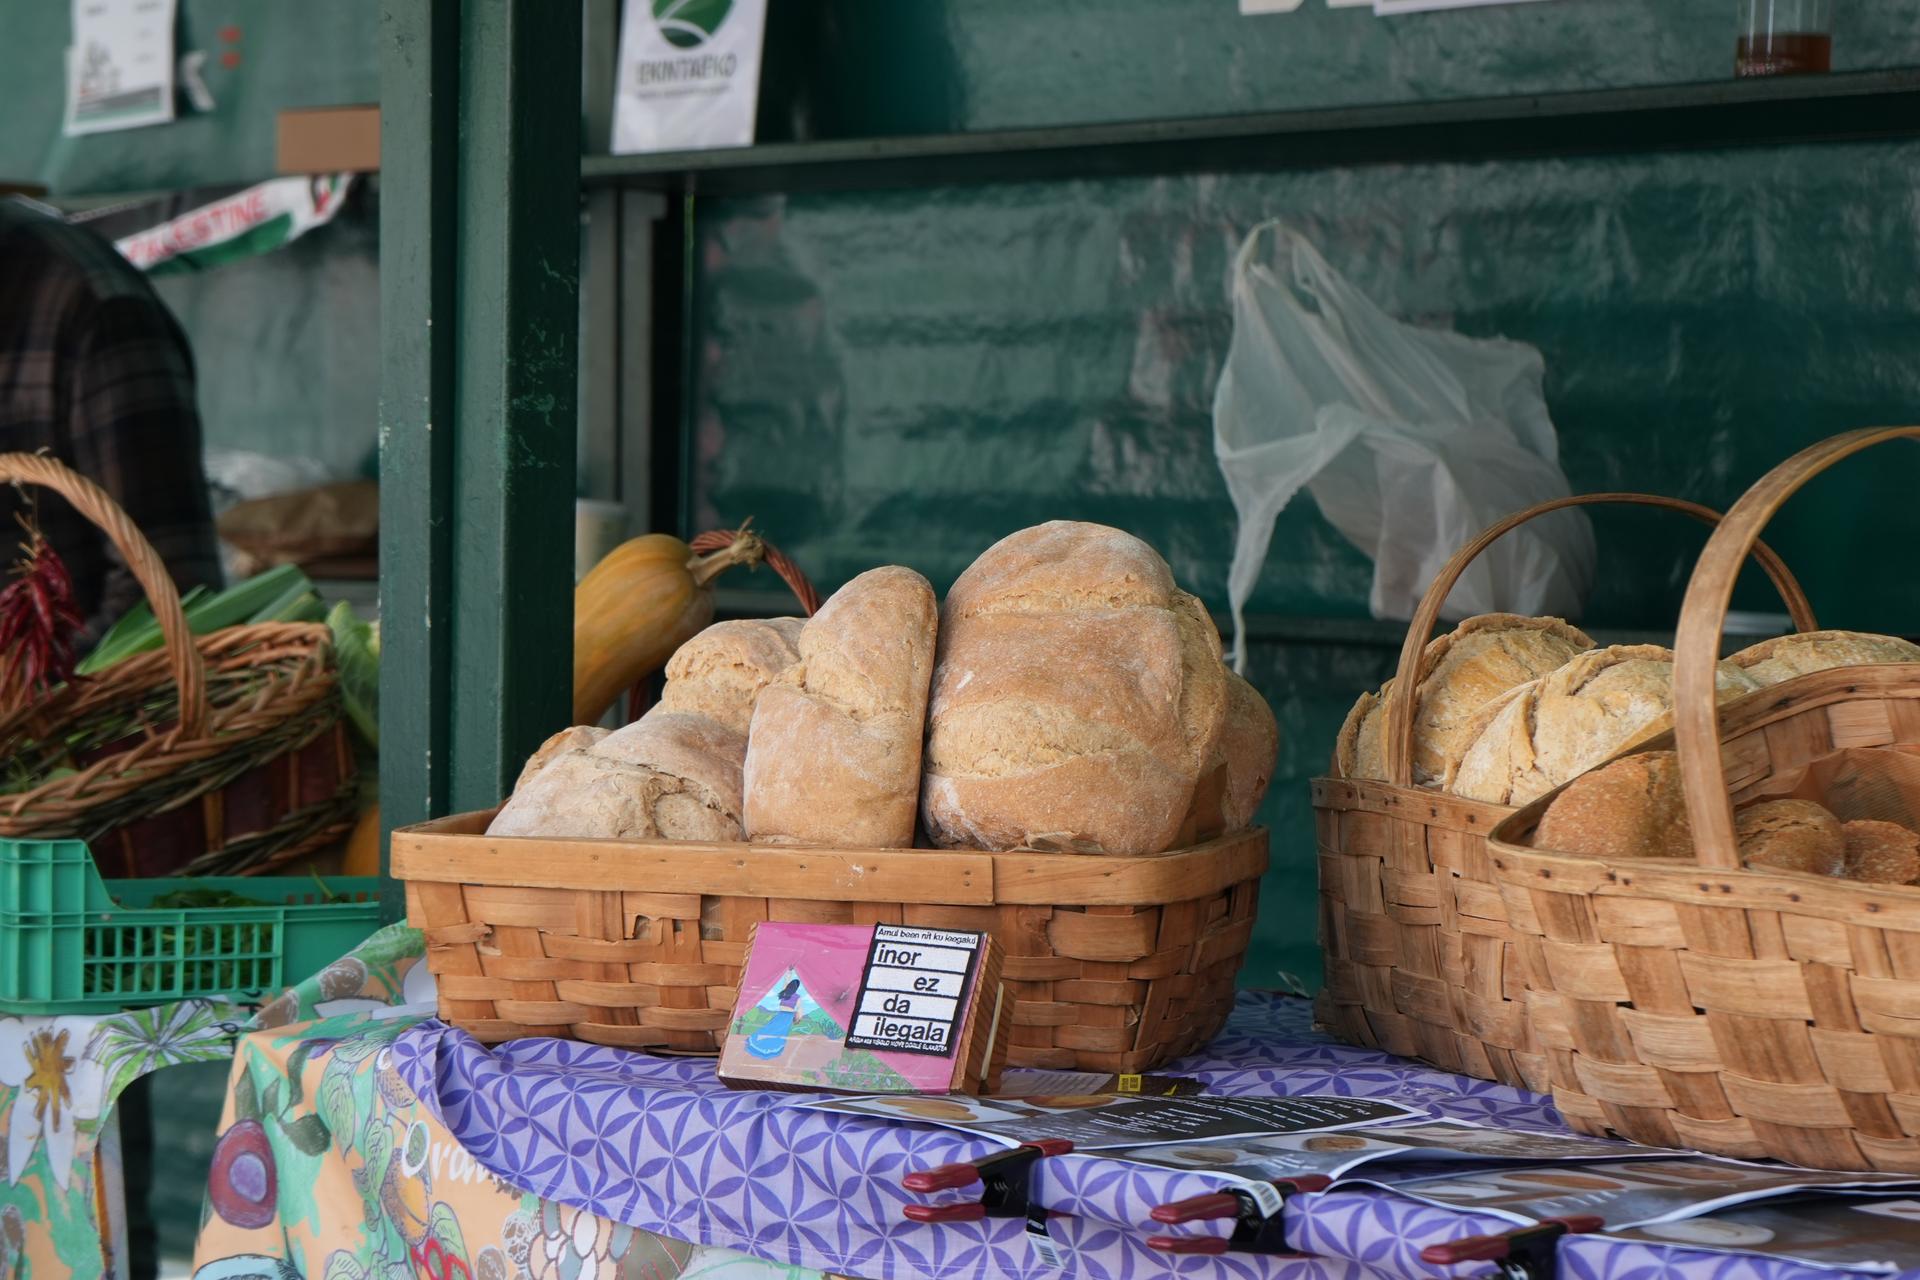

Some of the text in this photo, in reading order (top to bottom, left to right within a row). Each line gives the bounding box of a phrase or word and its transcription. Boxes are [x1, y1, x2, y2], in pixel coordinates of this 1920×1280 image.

[877, 944, 922, 965] inor
[914, 976, 940, 992] ez
[883, 994, 911, 1014] da
[873, 1017, 944, 1042] ilegala
